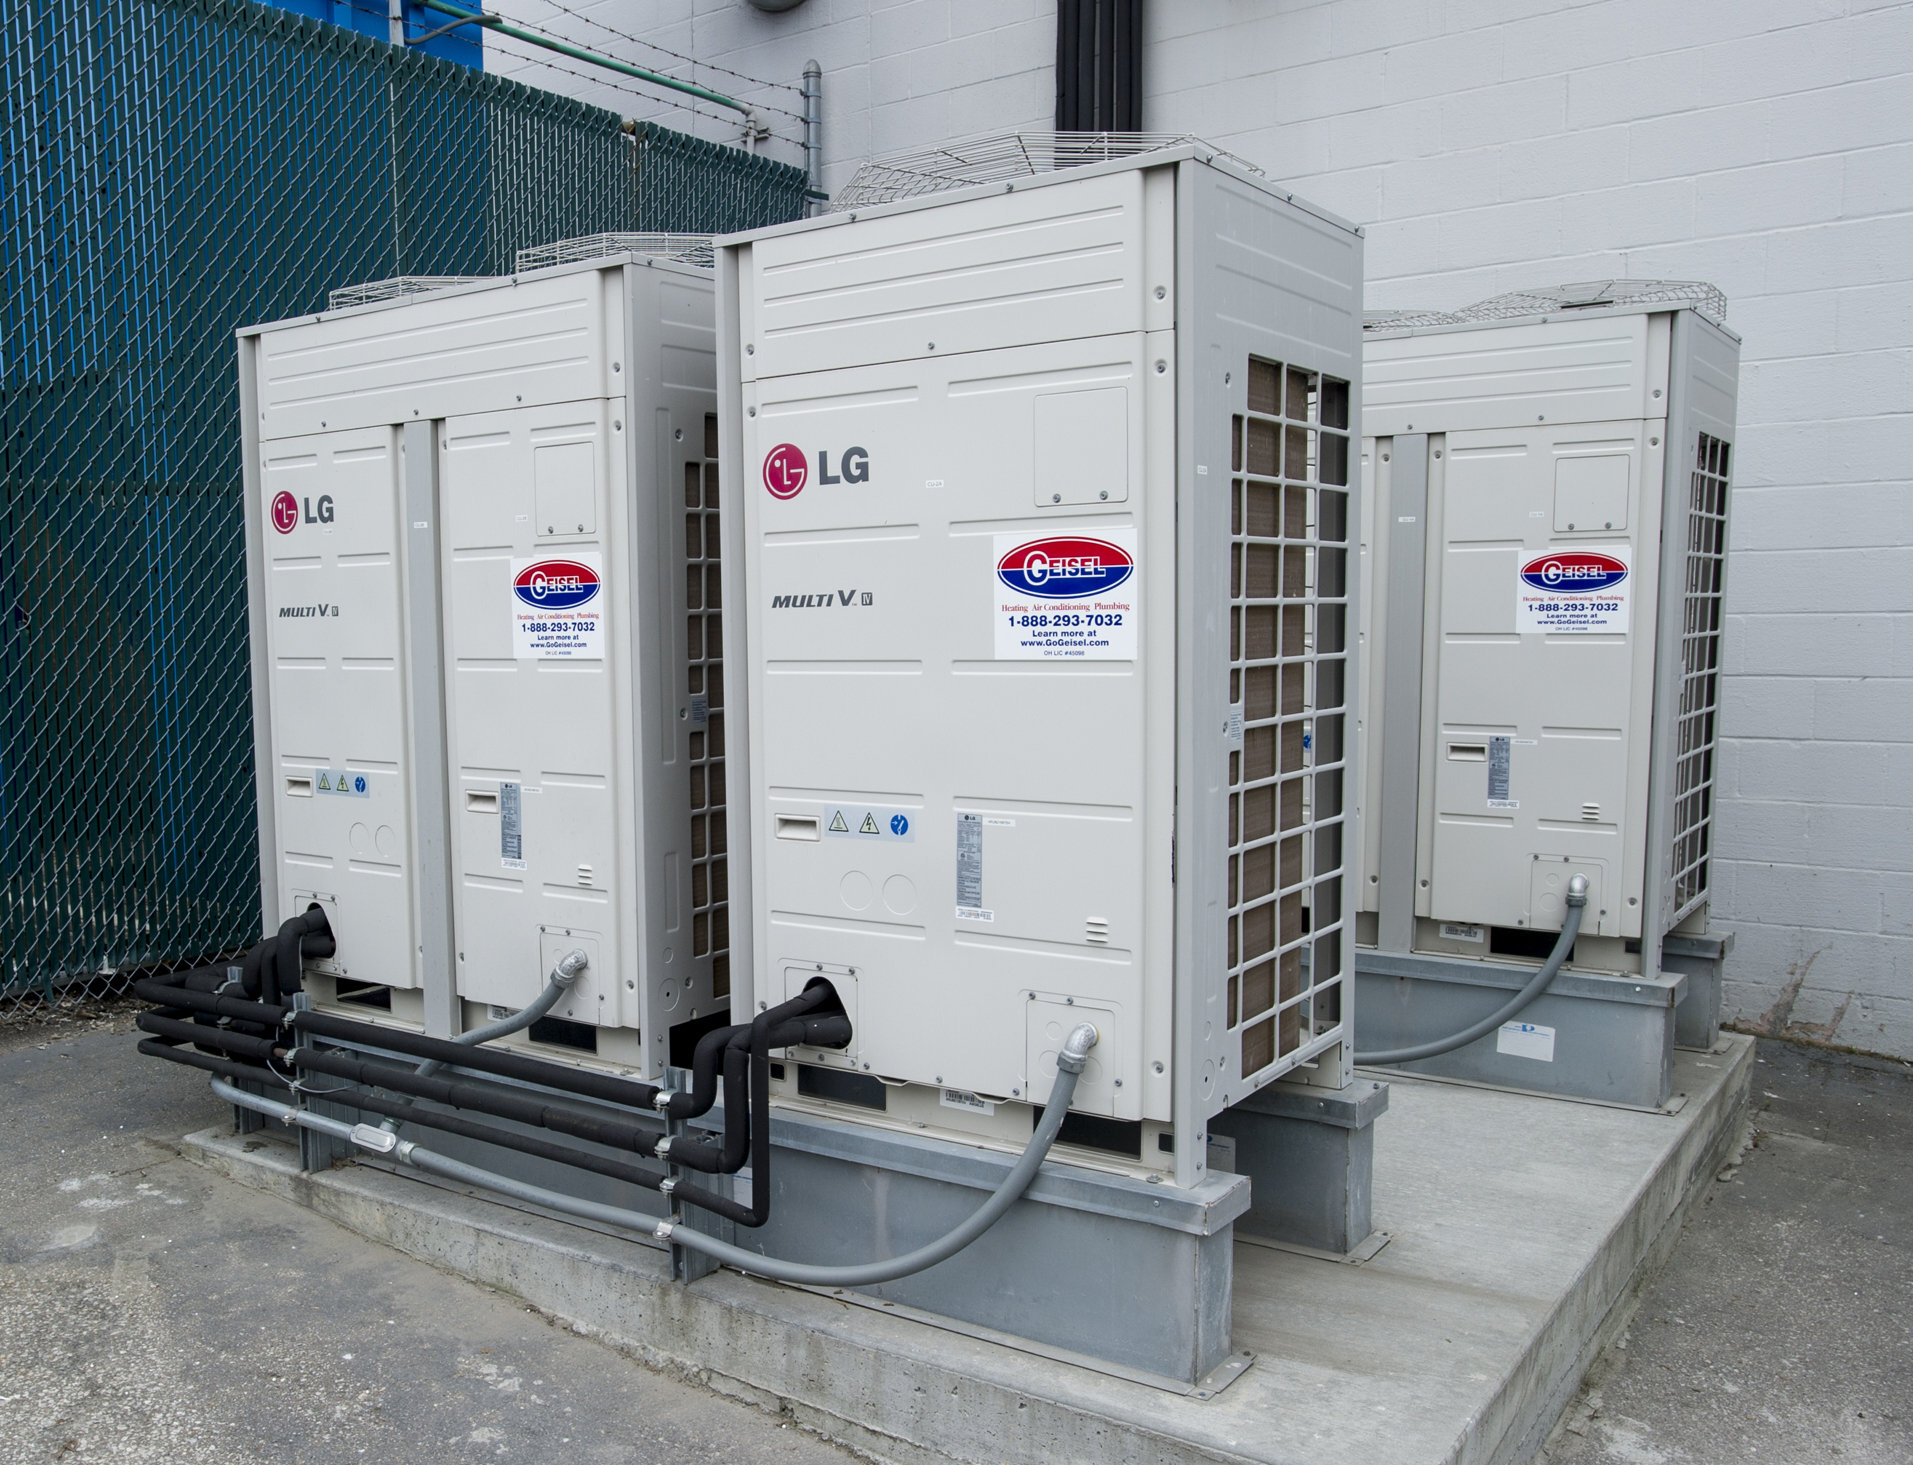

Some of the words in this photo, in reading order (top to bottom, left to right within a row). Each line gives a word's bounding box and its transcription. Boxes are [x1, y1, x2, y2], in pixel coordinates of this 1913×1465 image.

[818, 446, 870, 485] LG
[304, 494, 335, 524] LG
[771, 593, 834, 609] MULTI
[279, 606, 316, 618] MULTI
[1001, 604, 1028, 613] Heating
[1044, 603, 1090, 612] Conditioning
[1094, 602, 1130, 611] Plumbing
[1528, 603, 1619, 612] 1-888-293-7032
[1008, 614, 1123, 627] 1-888-293-7032
[521, 621, 595, 632] 1-888-293-7032
[1032, 630, 1058, 638] Learn
[1087, 629, 1097, 637] at
[1020, 639, 1110, 647] www.GoGeisel.com
